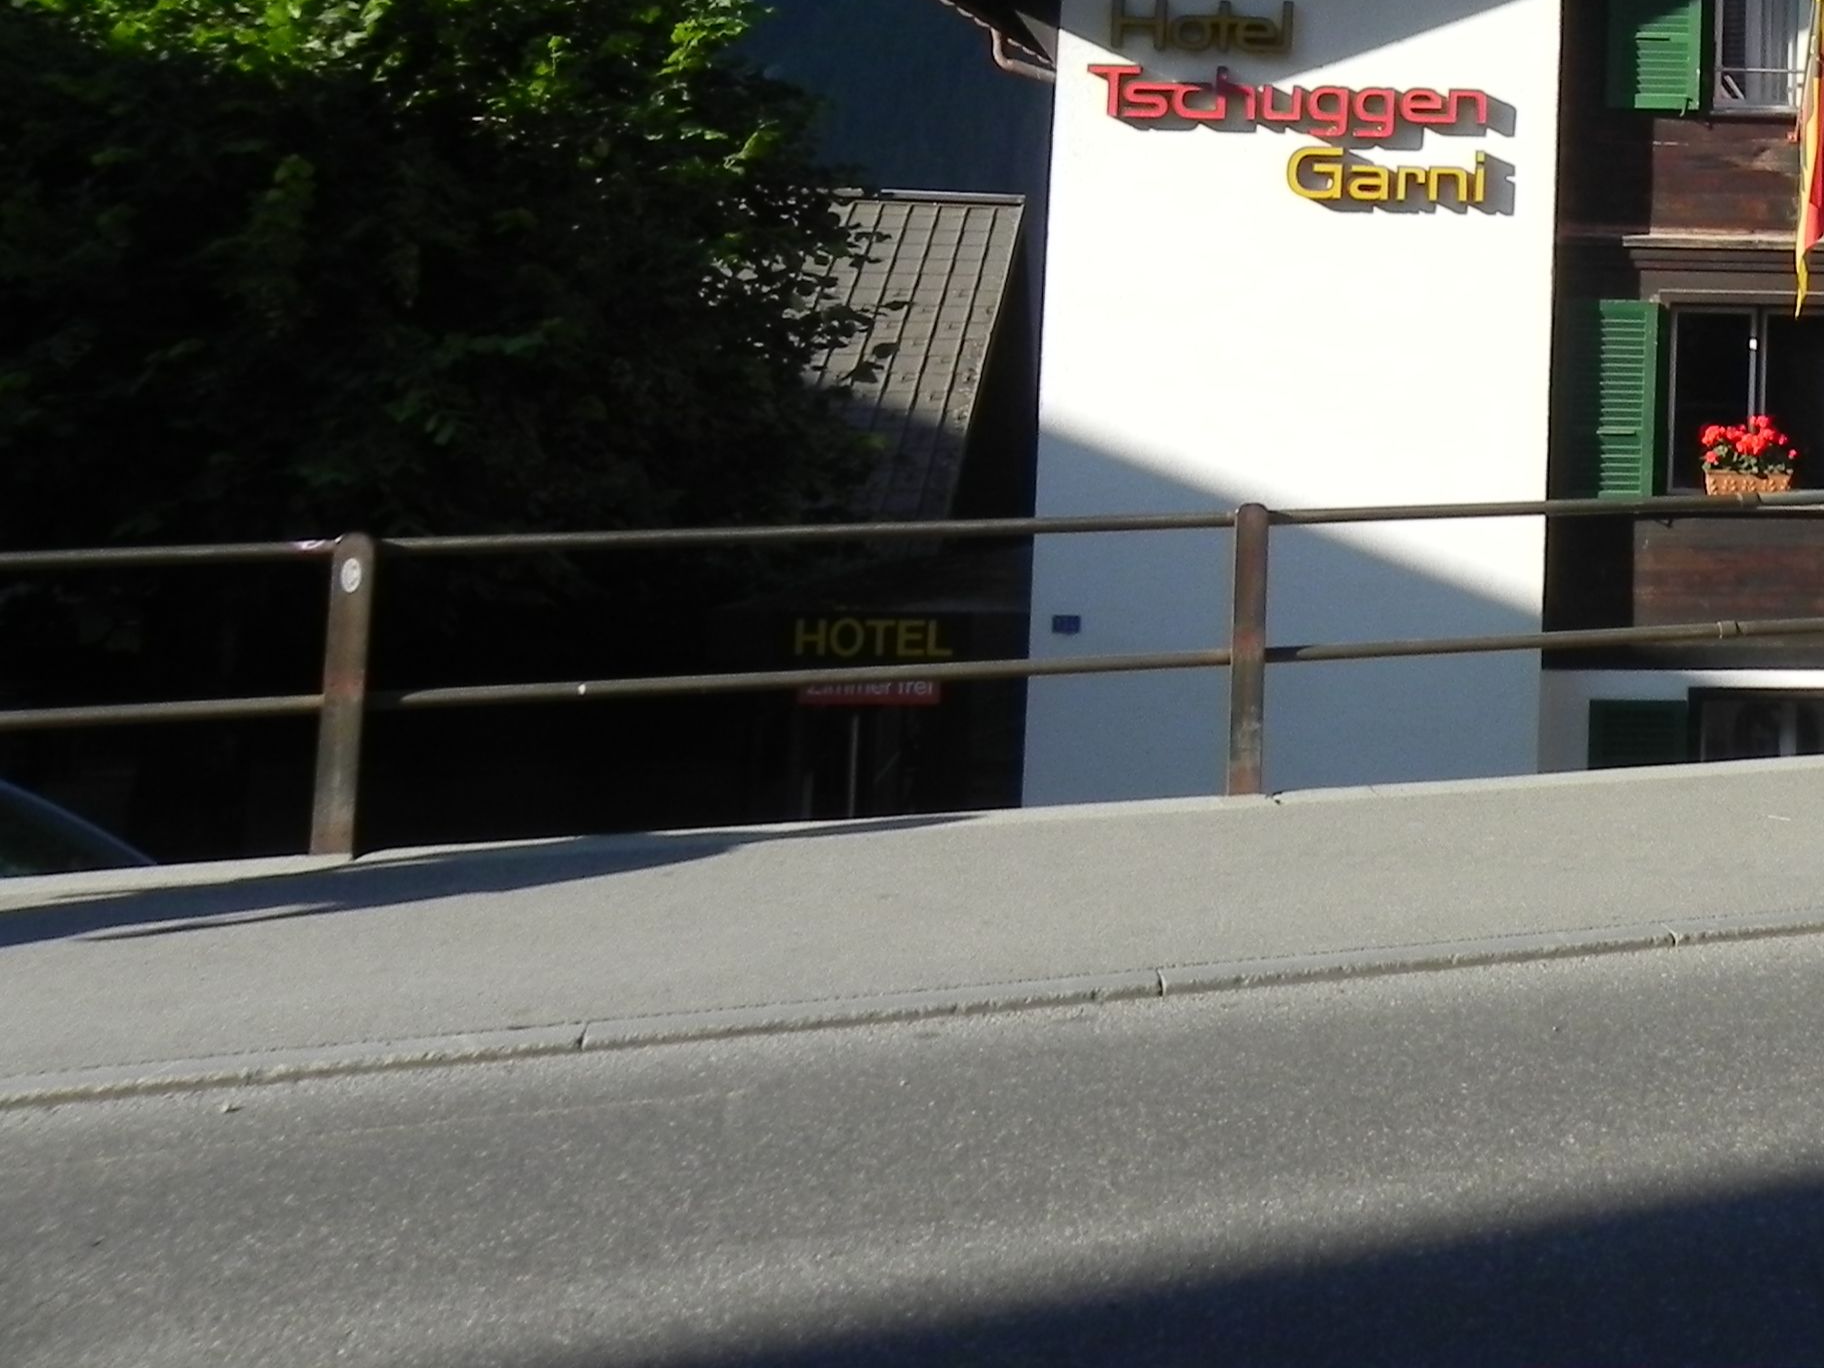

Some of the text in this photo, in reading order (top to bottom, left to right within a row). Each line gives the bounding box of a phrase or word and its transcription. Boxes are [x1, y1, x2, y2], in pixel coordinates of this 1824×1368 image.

[1087, 63, 1488, 139] Tschuggen
[1286, 146, 1486, 203] Garni
[793, 617, 953, 658] HOTEL
